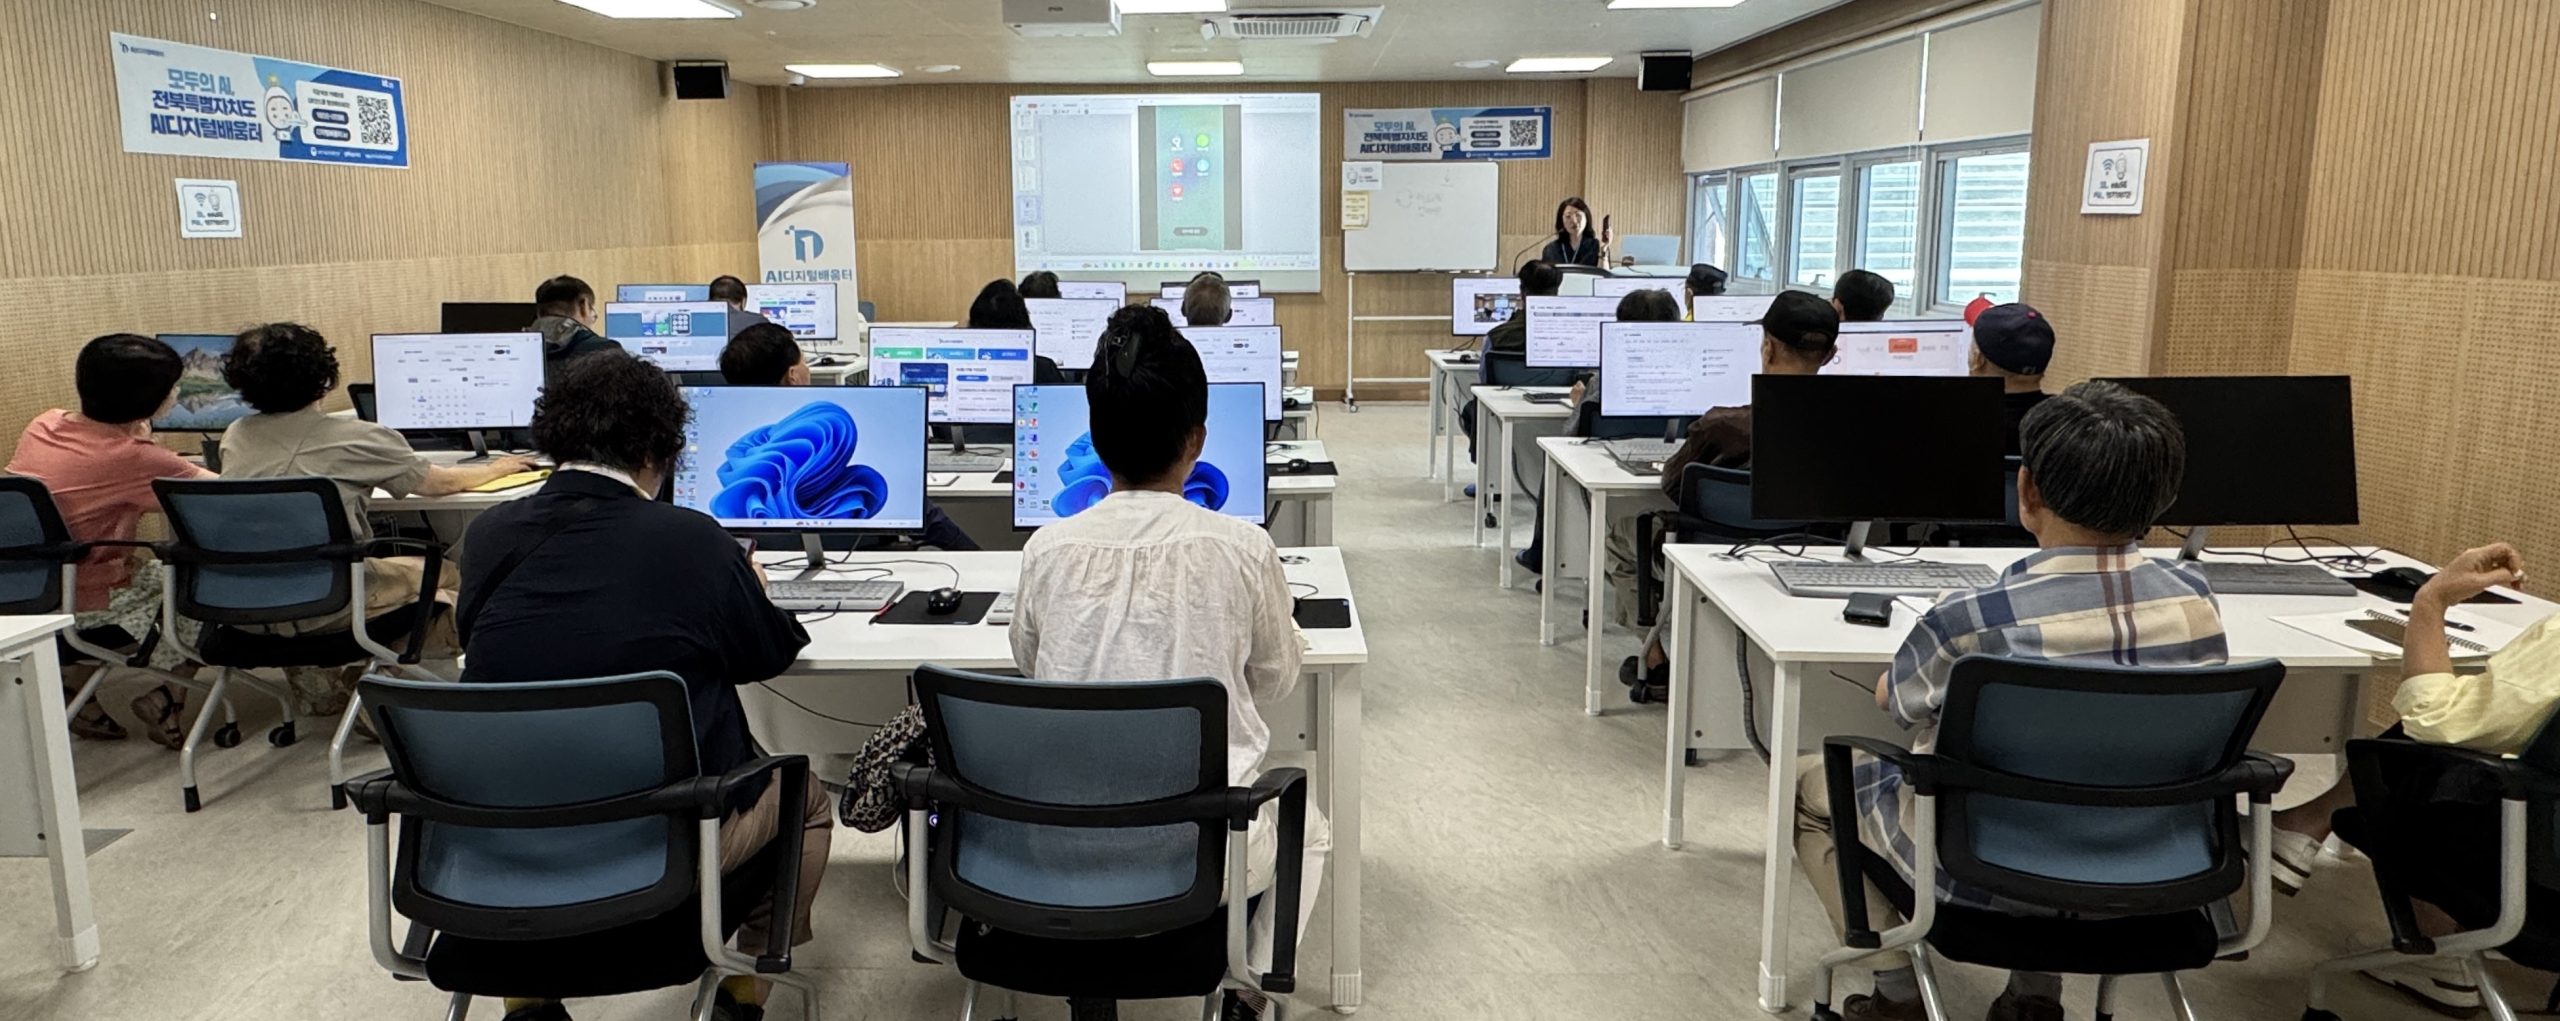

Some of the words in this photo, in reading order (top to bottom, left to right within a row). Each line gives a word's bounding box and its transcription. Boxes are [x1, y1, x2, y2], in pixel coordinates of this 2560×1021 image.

[167, 68, 216, 94] 모두의
[152, 90, 257, 118] 전북특별자치도
[150, 113, 263, 143] AI디지털배움터
[765, 269, 853, 283] AI디지털배움터
